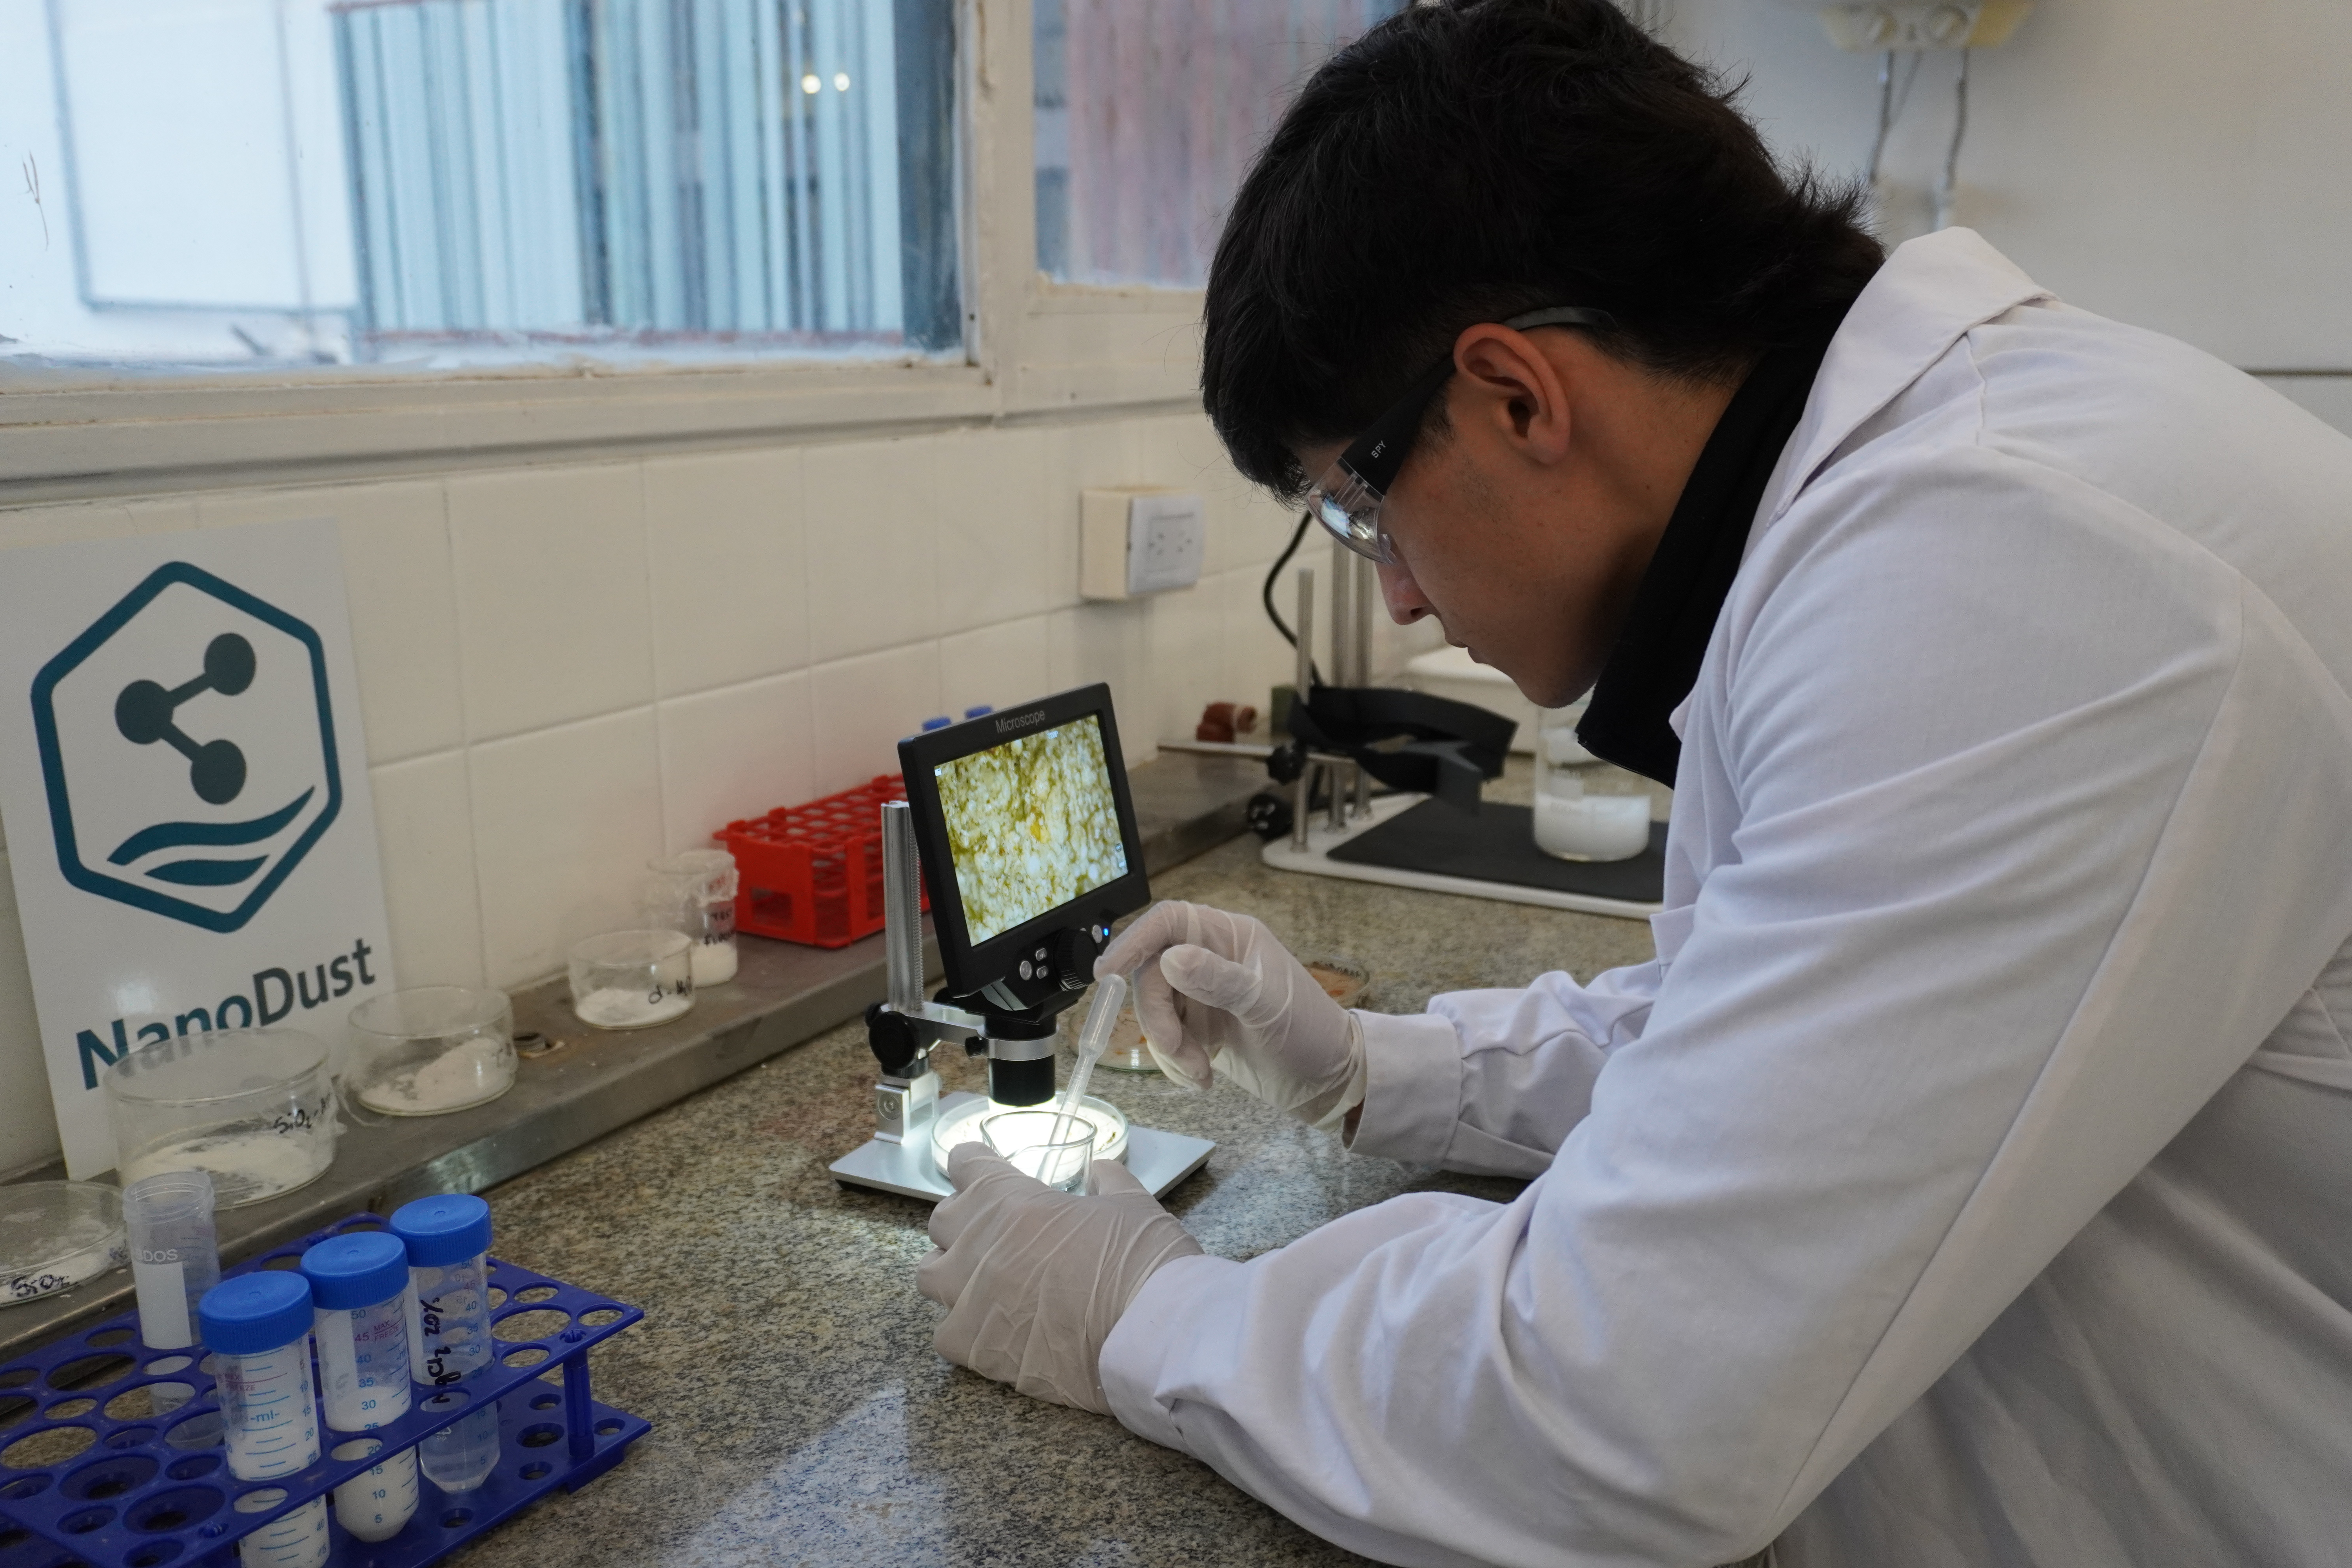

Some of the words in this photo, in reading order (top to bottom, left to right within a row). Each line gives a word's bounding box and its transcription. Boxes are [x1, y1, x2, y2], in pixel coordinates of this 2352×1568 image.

[1371, 440, 1386, 458] SPY
[995, 710, 1045, 734] Microscope
[1047, 730, 1058, 740] 720P
[76, 938, 375, 1090] NanoDust
[465, 1301, 477, 1312] 40
[351, 1309, 366, 1320] 50
[374, 1320, 390, 1331] MAX
[468, 1322, 479, 1334] 35
[355, 1332, 370, 1341] 45
[374, 1324, 400, 1341] FREEZE
[469, 1344, 481, 1356] 30
[357, 1354, 372, 1364] 40
[300, 1380, 309, 1392] 10
[359, 1377, 374, 1388] 35
[362, 1399, 376, 1410] 30
[250, 1410, 280, 1422] -ml-
[303, 1404, 311, 1417] 15
[305, 1427, 314, 1441] 20
[478, 1430, 488, 1442] 10
[367, 1445, 381, 1455] 20
[480, 1455, 486, 1465] 5
[370, 1465, 383, 1476] 15
[372, 1489, 386, 1500] 10
[375, 1513, 383, 1524] 5
[316, 1518, 325, 1531] 40
